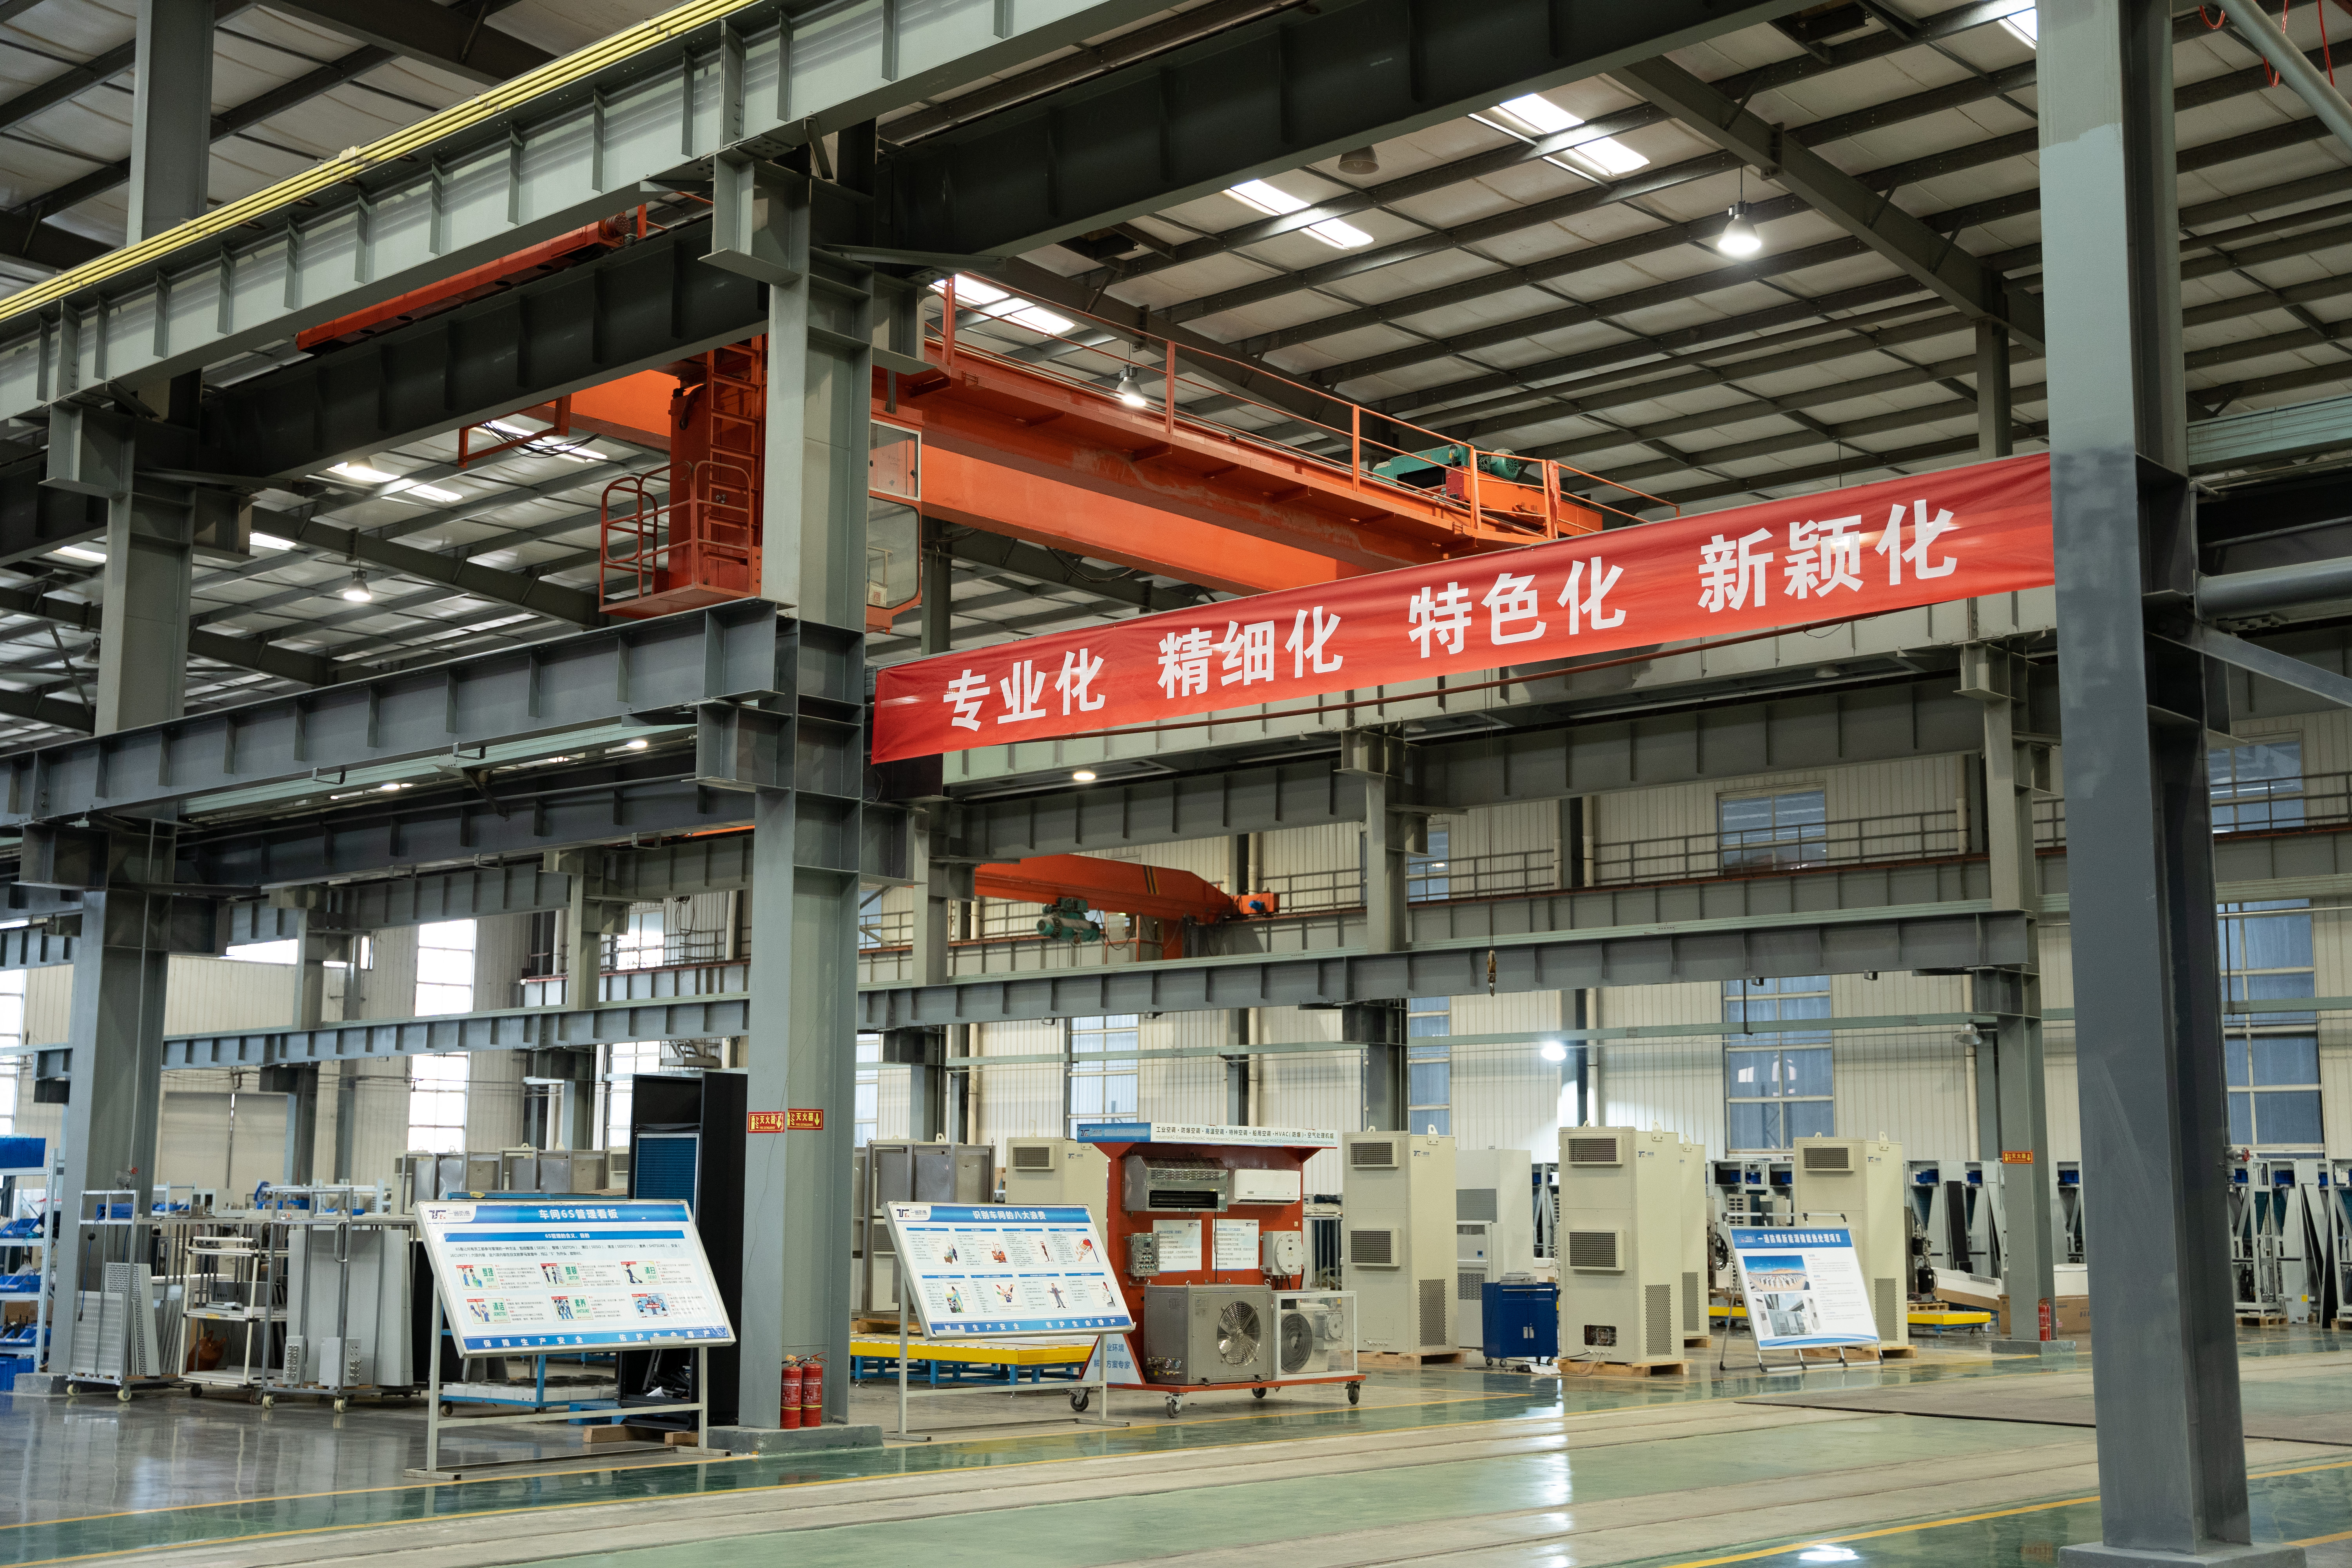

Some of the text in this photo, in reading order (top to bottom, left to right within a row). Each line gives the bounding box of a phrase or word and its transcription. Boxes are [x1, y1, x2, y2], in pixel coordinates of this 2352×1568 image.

[943, 499, 1958, 731] 专业化 精细化 特色化 新颖化
[760, 1115, 775, 1124] 灭火器
[796, 1112, 814, 1121] 灭火器
[539, 1209, 619, 1220] 车间6S管理看板
[973, 1210, 1046, 1220] 识别车间的八大浪费
[483, 1268, 494, 1276] 整理
[565, 1267, 577, 1275] 整顿
[493, 1302, 505, 1310] 清洁
[575, 1299, 586, 1307] 素养
[944, 1319, 1116, 1331] 保障生产安全 佑护生命尊严
[483, 1336, 583, 1347] 保障生产安全
[1094, 1359, 1130, 1369] 解方案专家
